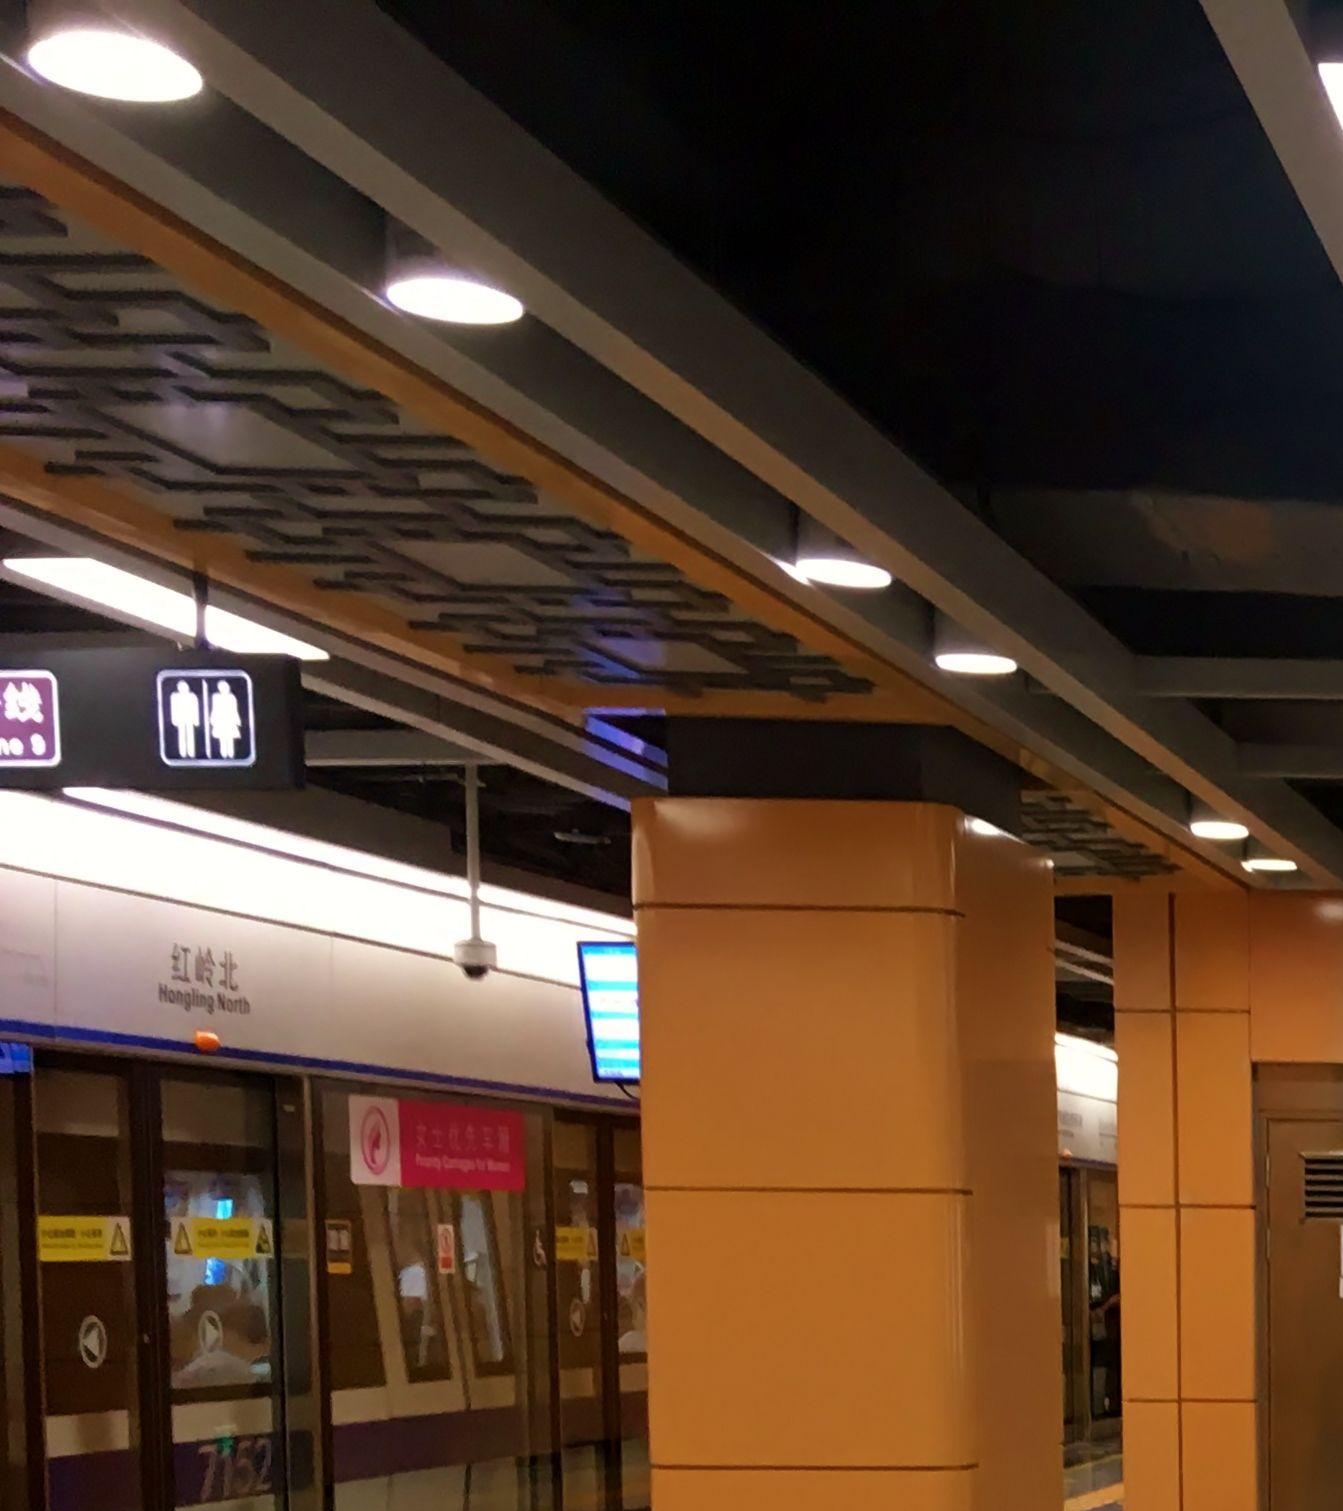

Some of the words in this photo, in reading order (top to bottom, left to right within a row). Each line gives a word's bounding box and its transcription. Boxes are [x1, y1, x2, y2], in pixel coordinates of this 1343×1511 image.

[171, 942, 239, 991] 红岭北
[158, 982, 215, 1014] Hongling
[217, 991, 250, 1015] North
